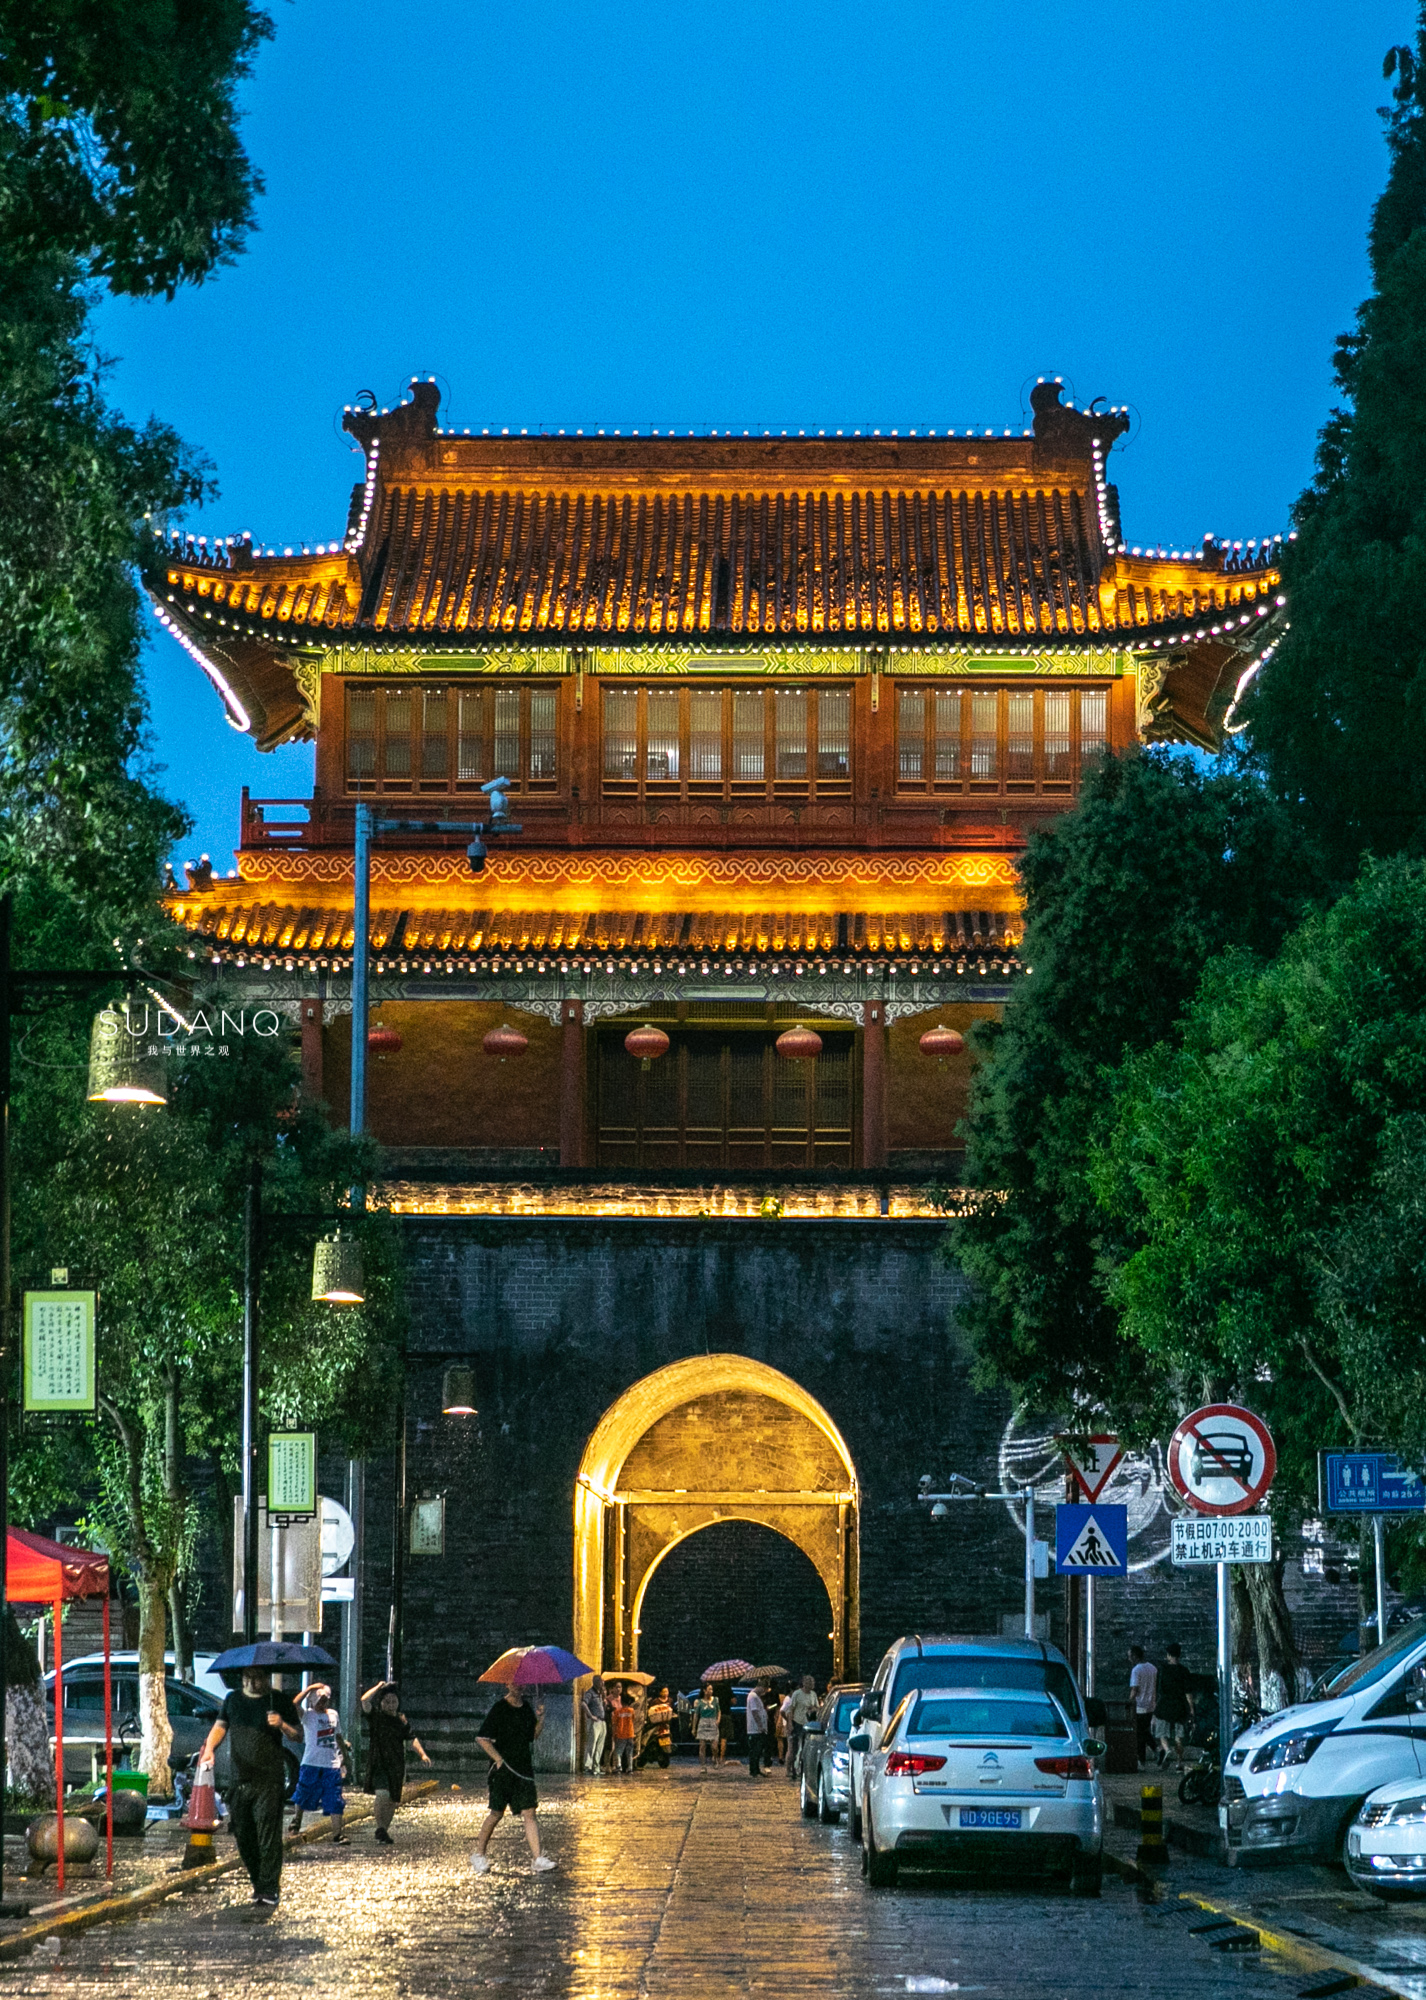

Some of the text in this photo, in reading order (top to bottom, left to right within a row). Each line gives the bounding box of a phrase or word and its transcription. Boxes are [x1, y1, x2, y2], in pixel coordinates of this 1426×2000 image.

[1175, 1540, 1268, 1560] 禁止机动车通行
